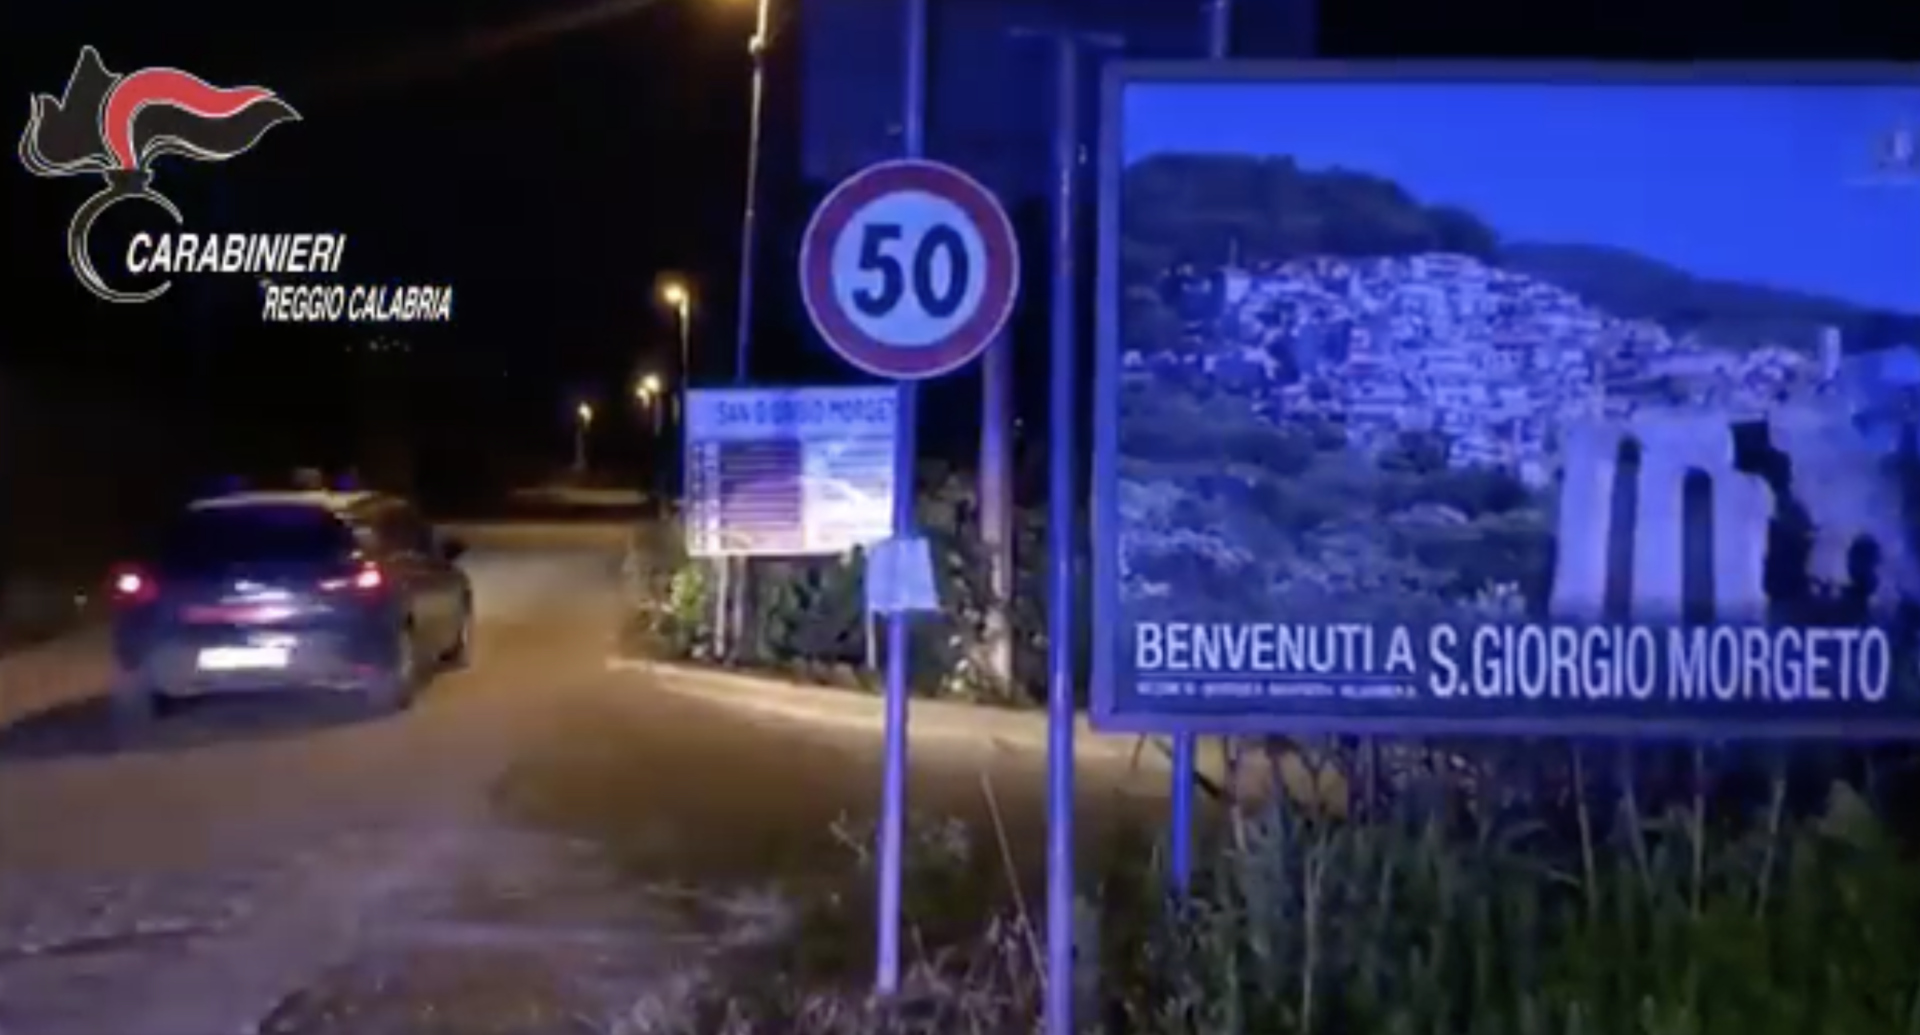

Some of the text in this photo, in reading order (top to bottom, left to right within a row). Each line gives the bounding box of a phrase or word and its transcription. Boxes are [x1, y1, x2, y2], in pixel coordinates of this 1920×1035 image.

[852, 223, 969, 318] 50
[717, 400, 750, 425] SAN
[754, 400, 824, 425] GORGO
[1136, 622, 1890, 701] BENVENUTI A S.GIORGIO MORGETO
